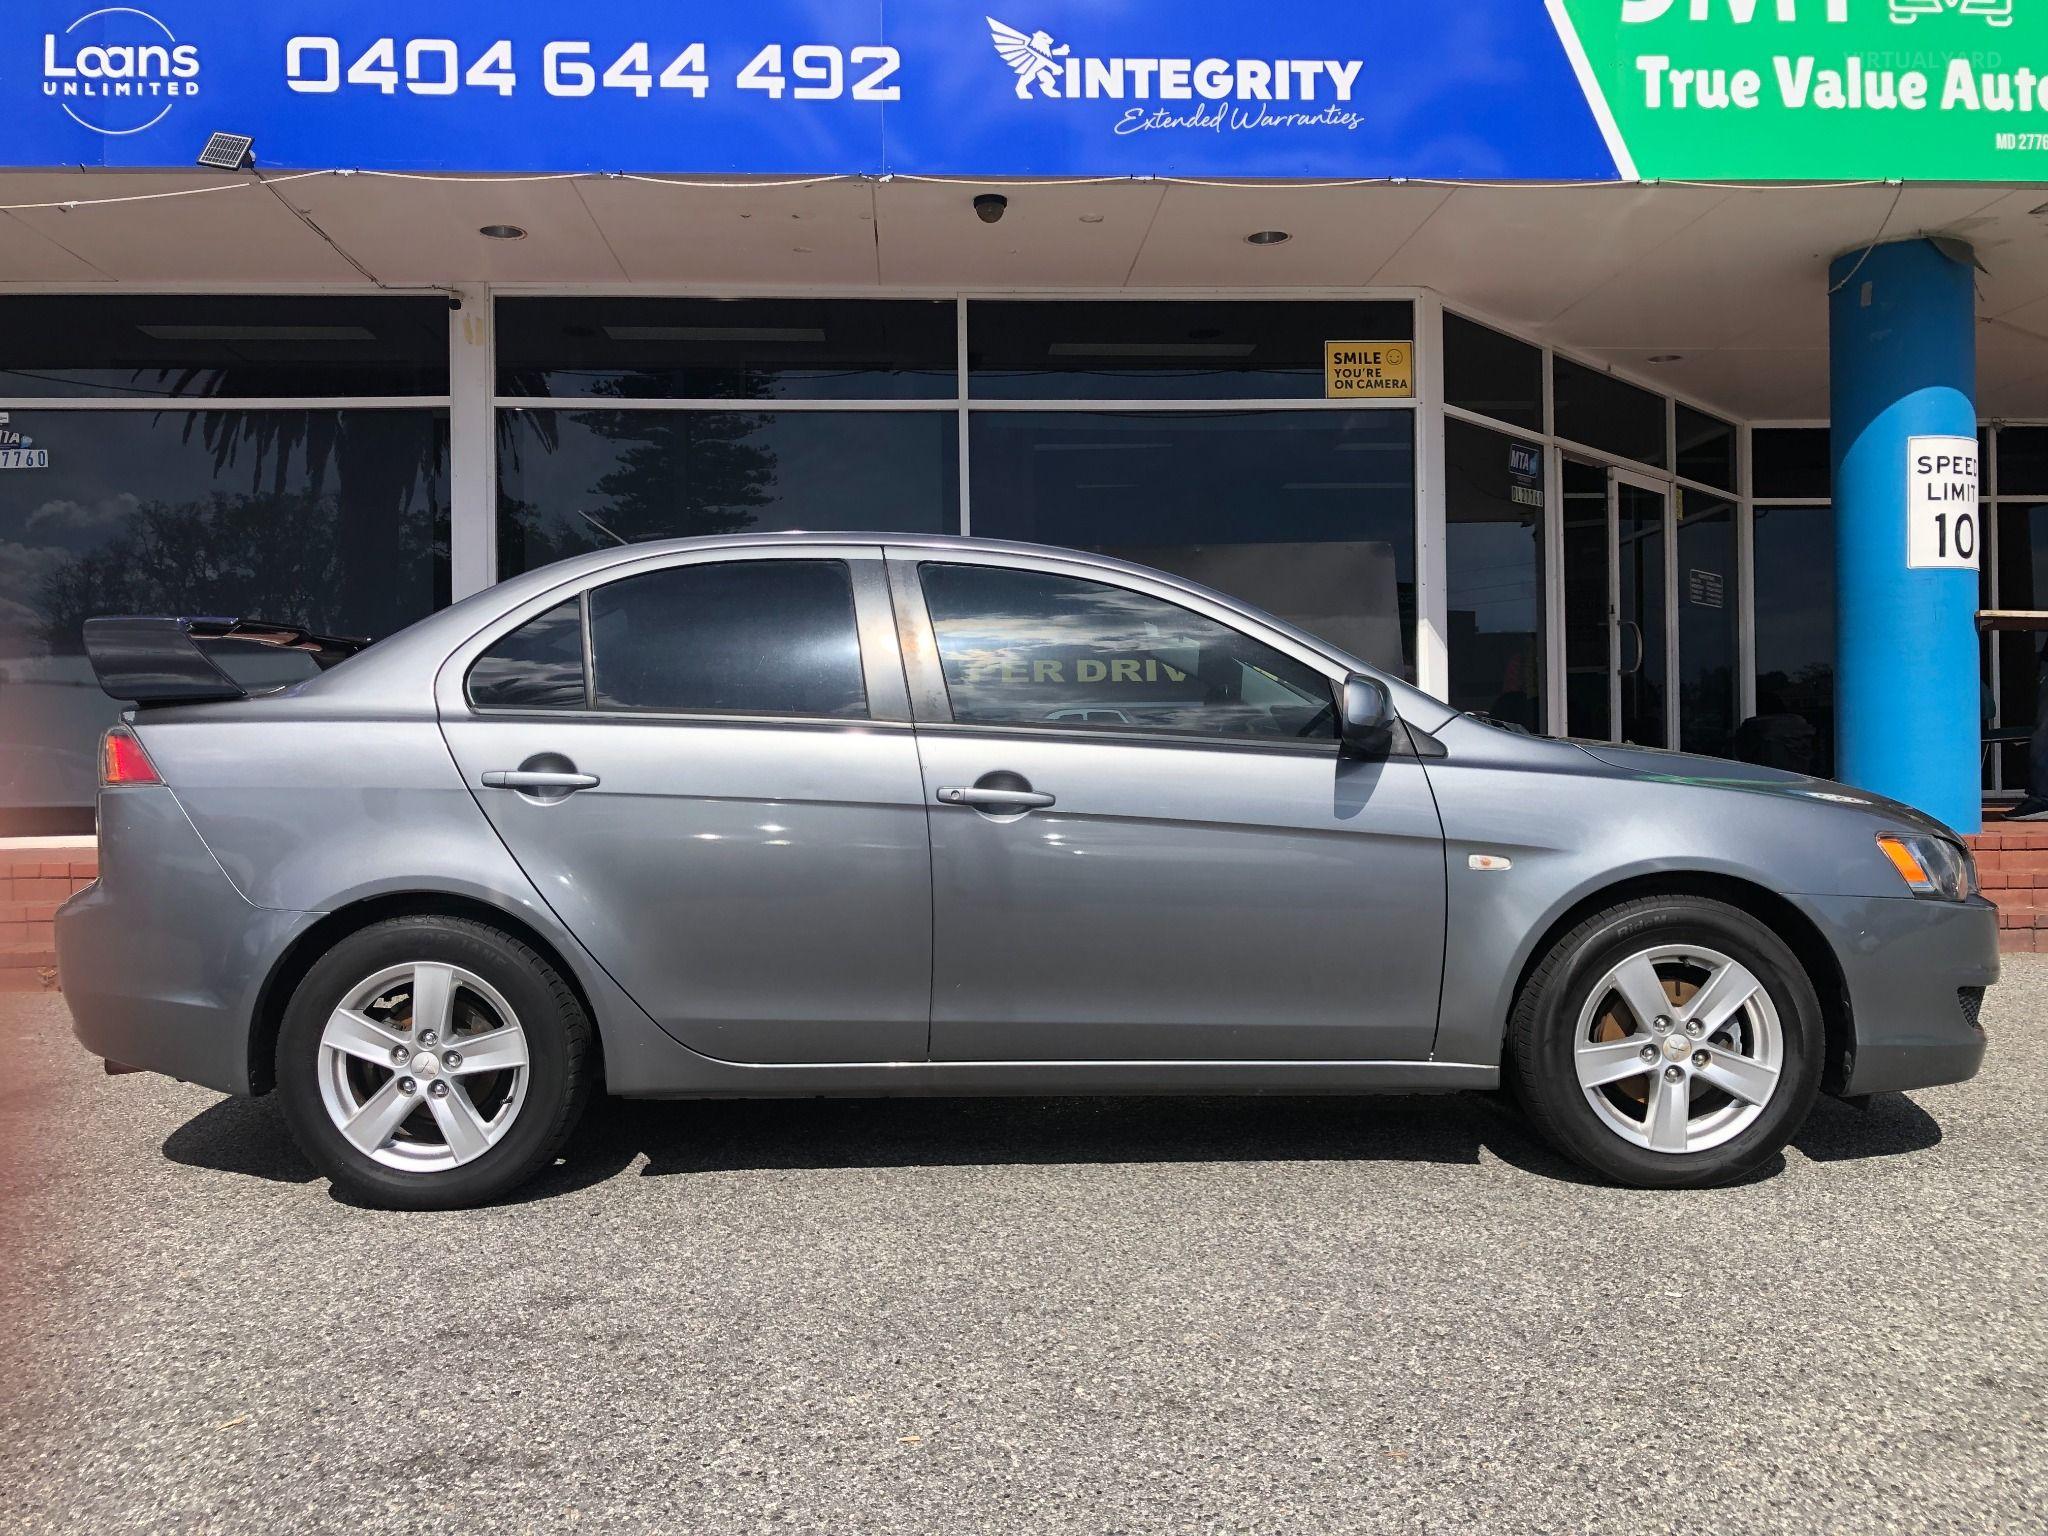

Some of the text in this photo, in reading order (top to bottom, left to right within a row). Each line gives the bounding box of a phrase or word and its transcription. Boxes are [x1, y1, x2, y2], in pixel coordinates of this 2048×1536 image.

[44, 34, 200, 78] Loans
[286, 36, 901, 101] 0404 644 492
[43, 81, 199, 96] UNLIMITED
[1065, 57, 1363, 101] INTEGRITY
[1635, 55, 1762, 109] True
[1773, 55, 1928, 110] Value
[1114, 101, 1364, 135] Extended Warranties
[1996, 133, 2016, 150] MD
[1334, 352, 1381, 364] SMILE
[1334, 368, 1381, 378] YOU'RE
[1335, 379, 1408, 389] ON CAMERA
[2, 451, 46, 466] 7760
[1510, 449, 1529, 471] MTA
[1928, 483, 1976, 502] LIMIT
[1935, 513, 1974, 559] 10
